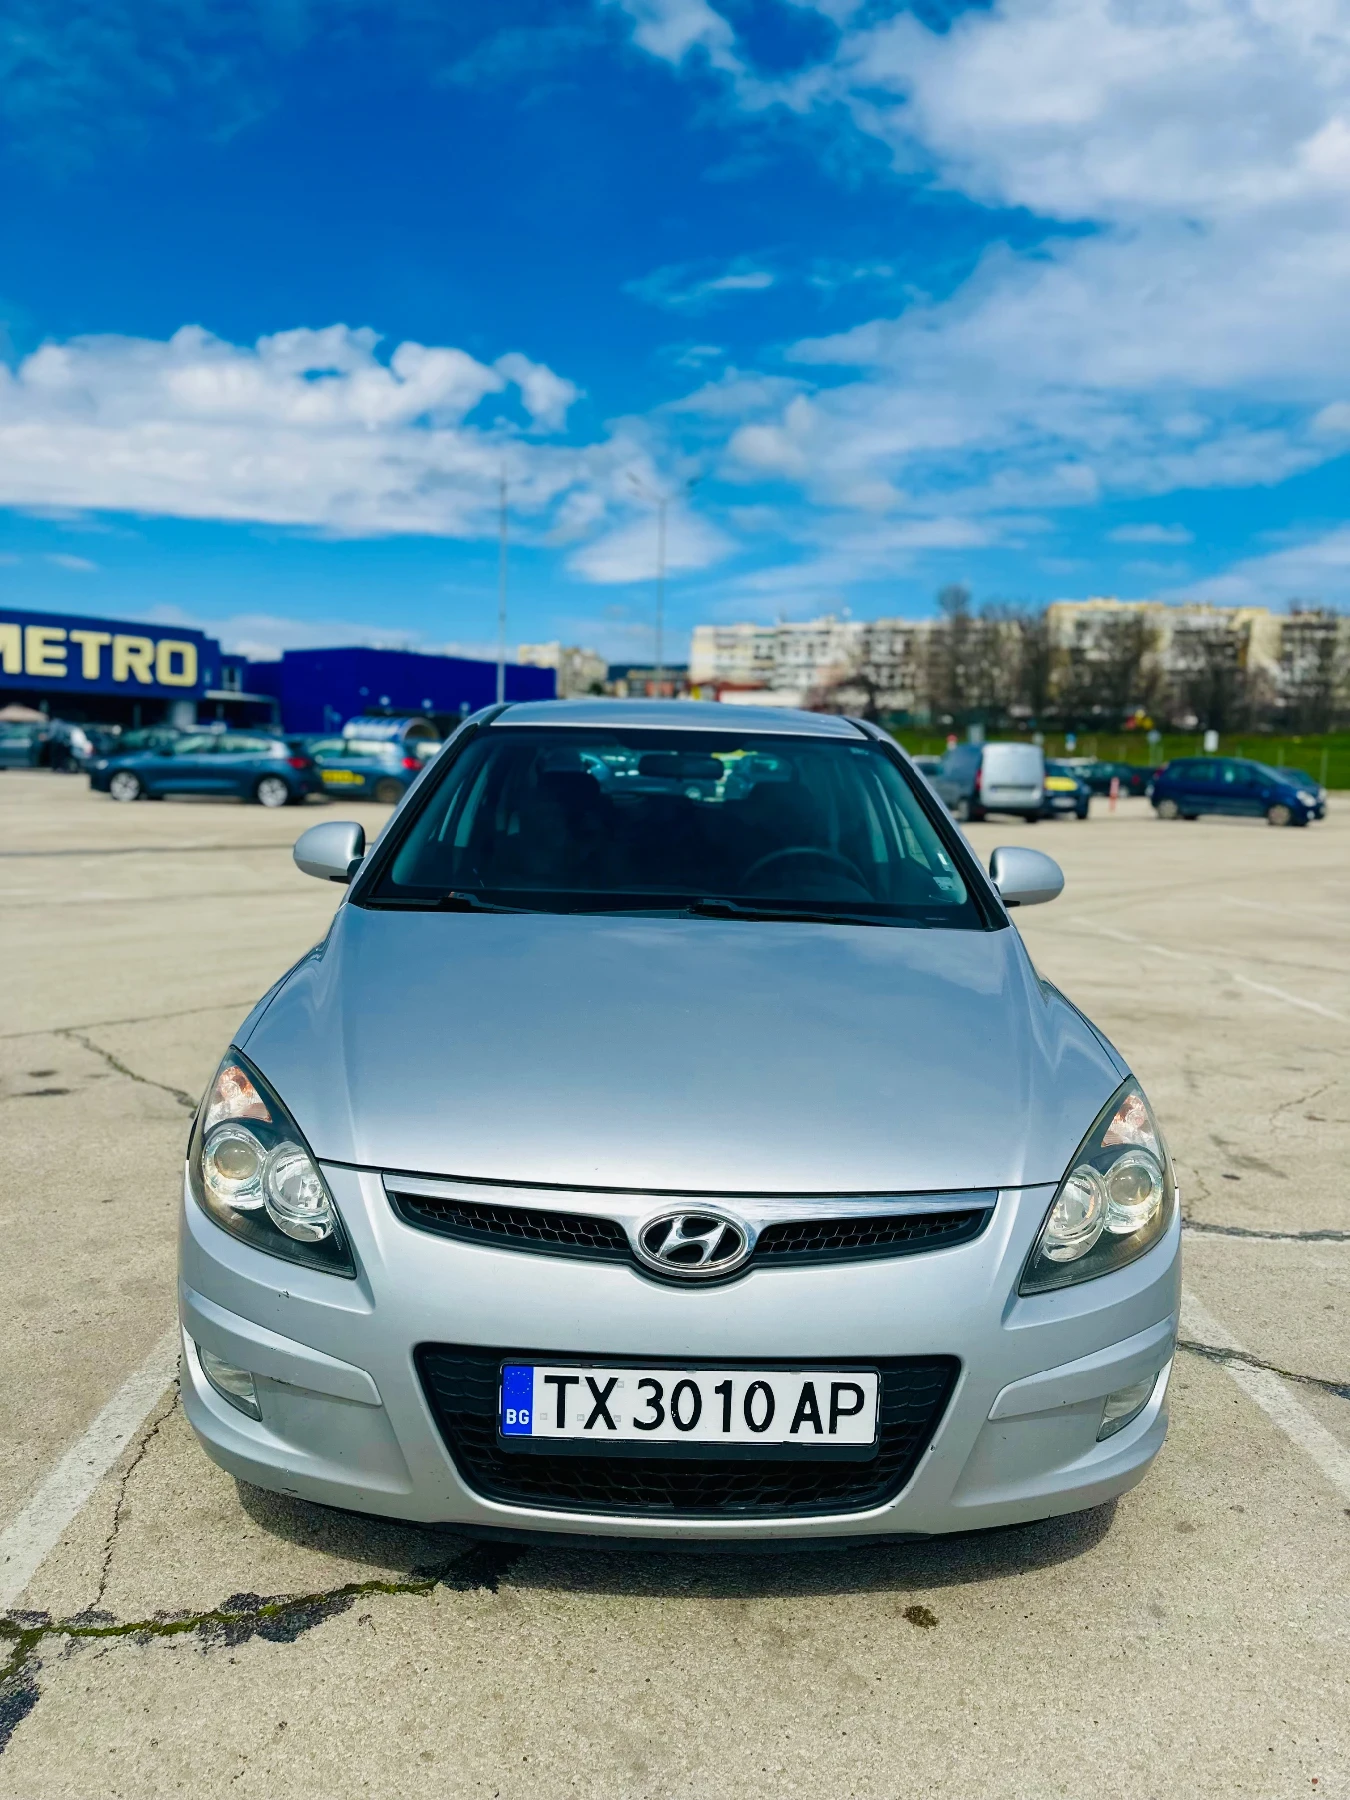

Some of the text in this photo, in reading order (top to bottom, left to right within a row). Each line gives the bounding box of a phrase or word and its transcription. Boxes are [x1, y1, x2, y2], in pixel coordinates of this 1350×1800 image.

[506, 1408, 530, 1425] BG
[543, 1374, 865, 1435] TX 3010 AP
